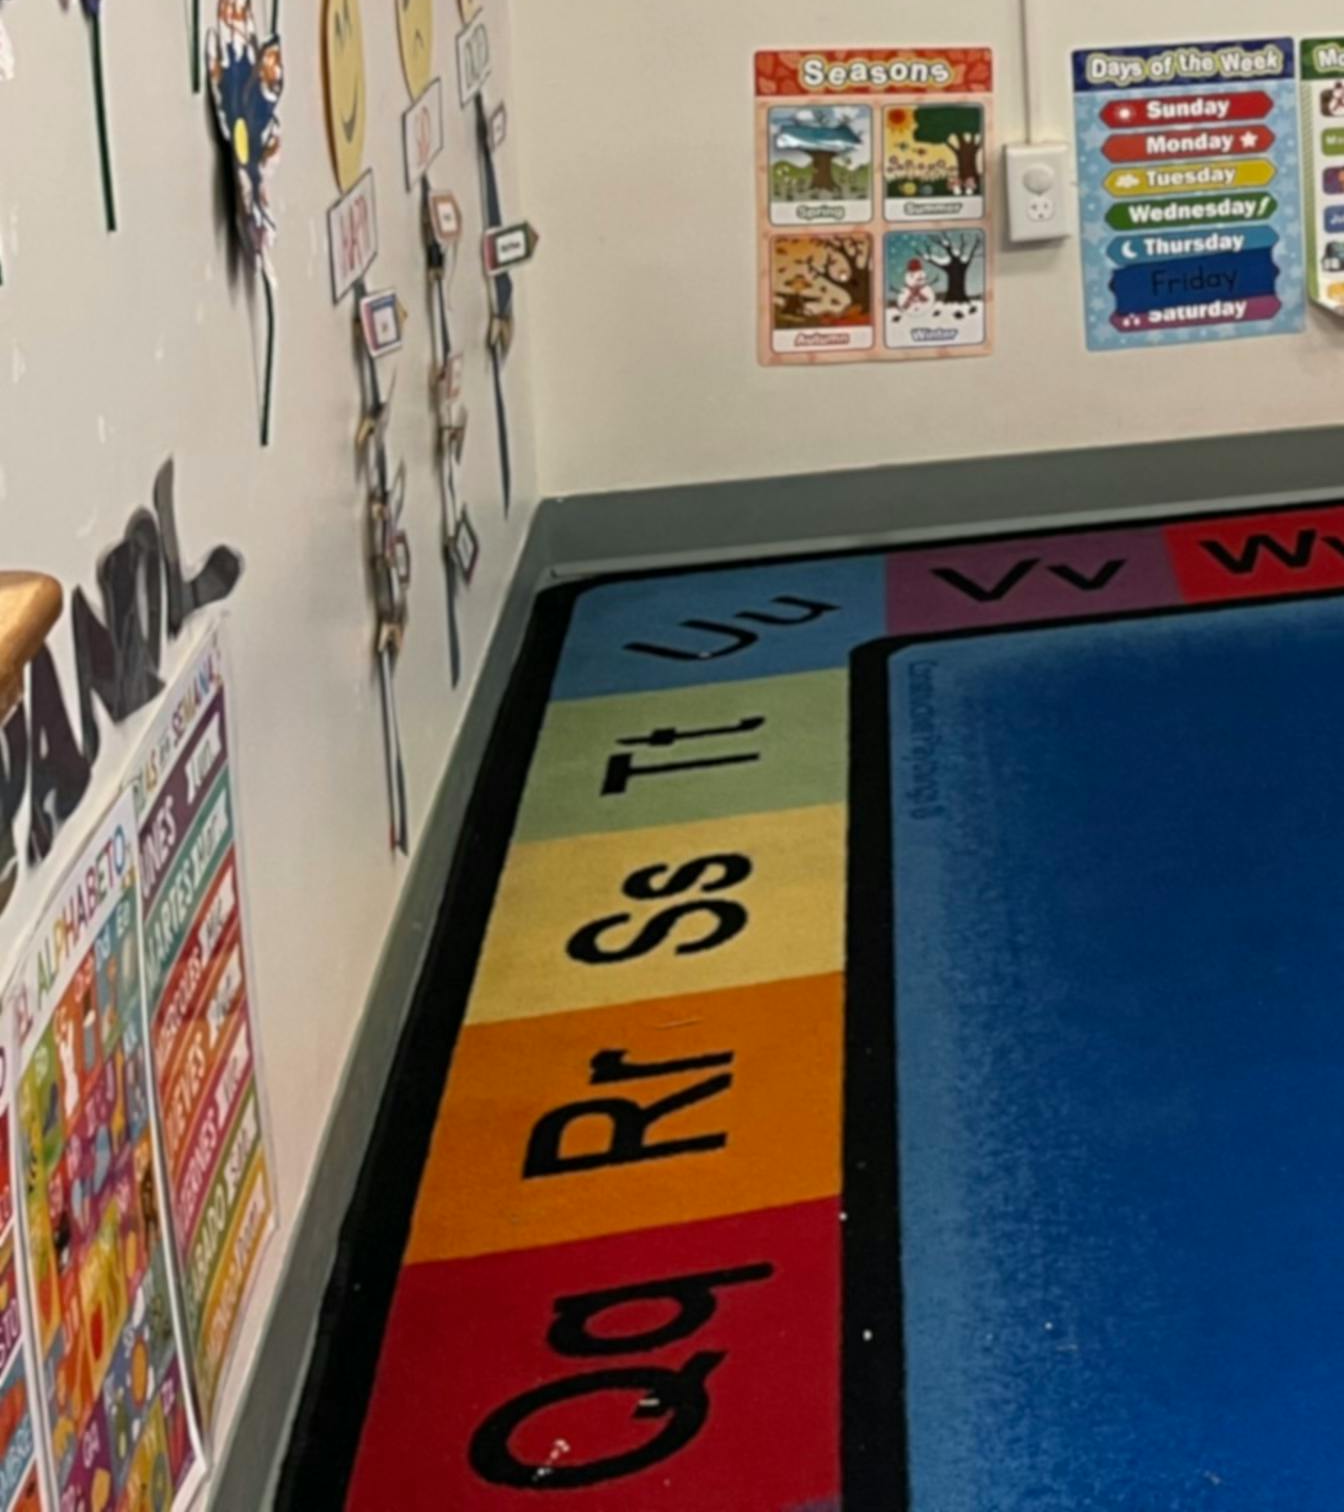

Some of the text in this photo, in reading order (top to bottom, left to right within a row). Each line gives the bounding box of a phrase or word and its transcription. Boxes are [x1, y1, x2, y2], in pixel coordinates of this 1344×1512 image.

[803, 60, 951, 86] Seasons
[1090, 50, 1281, 84] Days of the Week
[1145, 98, 1230, 119] Sunday
[1145, 131, 1234, 155] Monday
[1146, 166, 1237, 188] Tuesday
[903, 201, 964, 216] Summer
[1128, 197, 1256, 223] Wednesday
[1142, 233, 1245, 256] Thursday
[1151, 268, 1238, 297] Friday
[910, 327, 959, 342] Winter
[929, 554, 1128, 606] Vv
[621, 592, 844, 662] Uu
[600, 716, 766, 798] Tt
[564, 852, 754, 966] Ss
[520, 1047, 736, 1182] Rr
[465, 1260, 776, 1491] Qq
